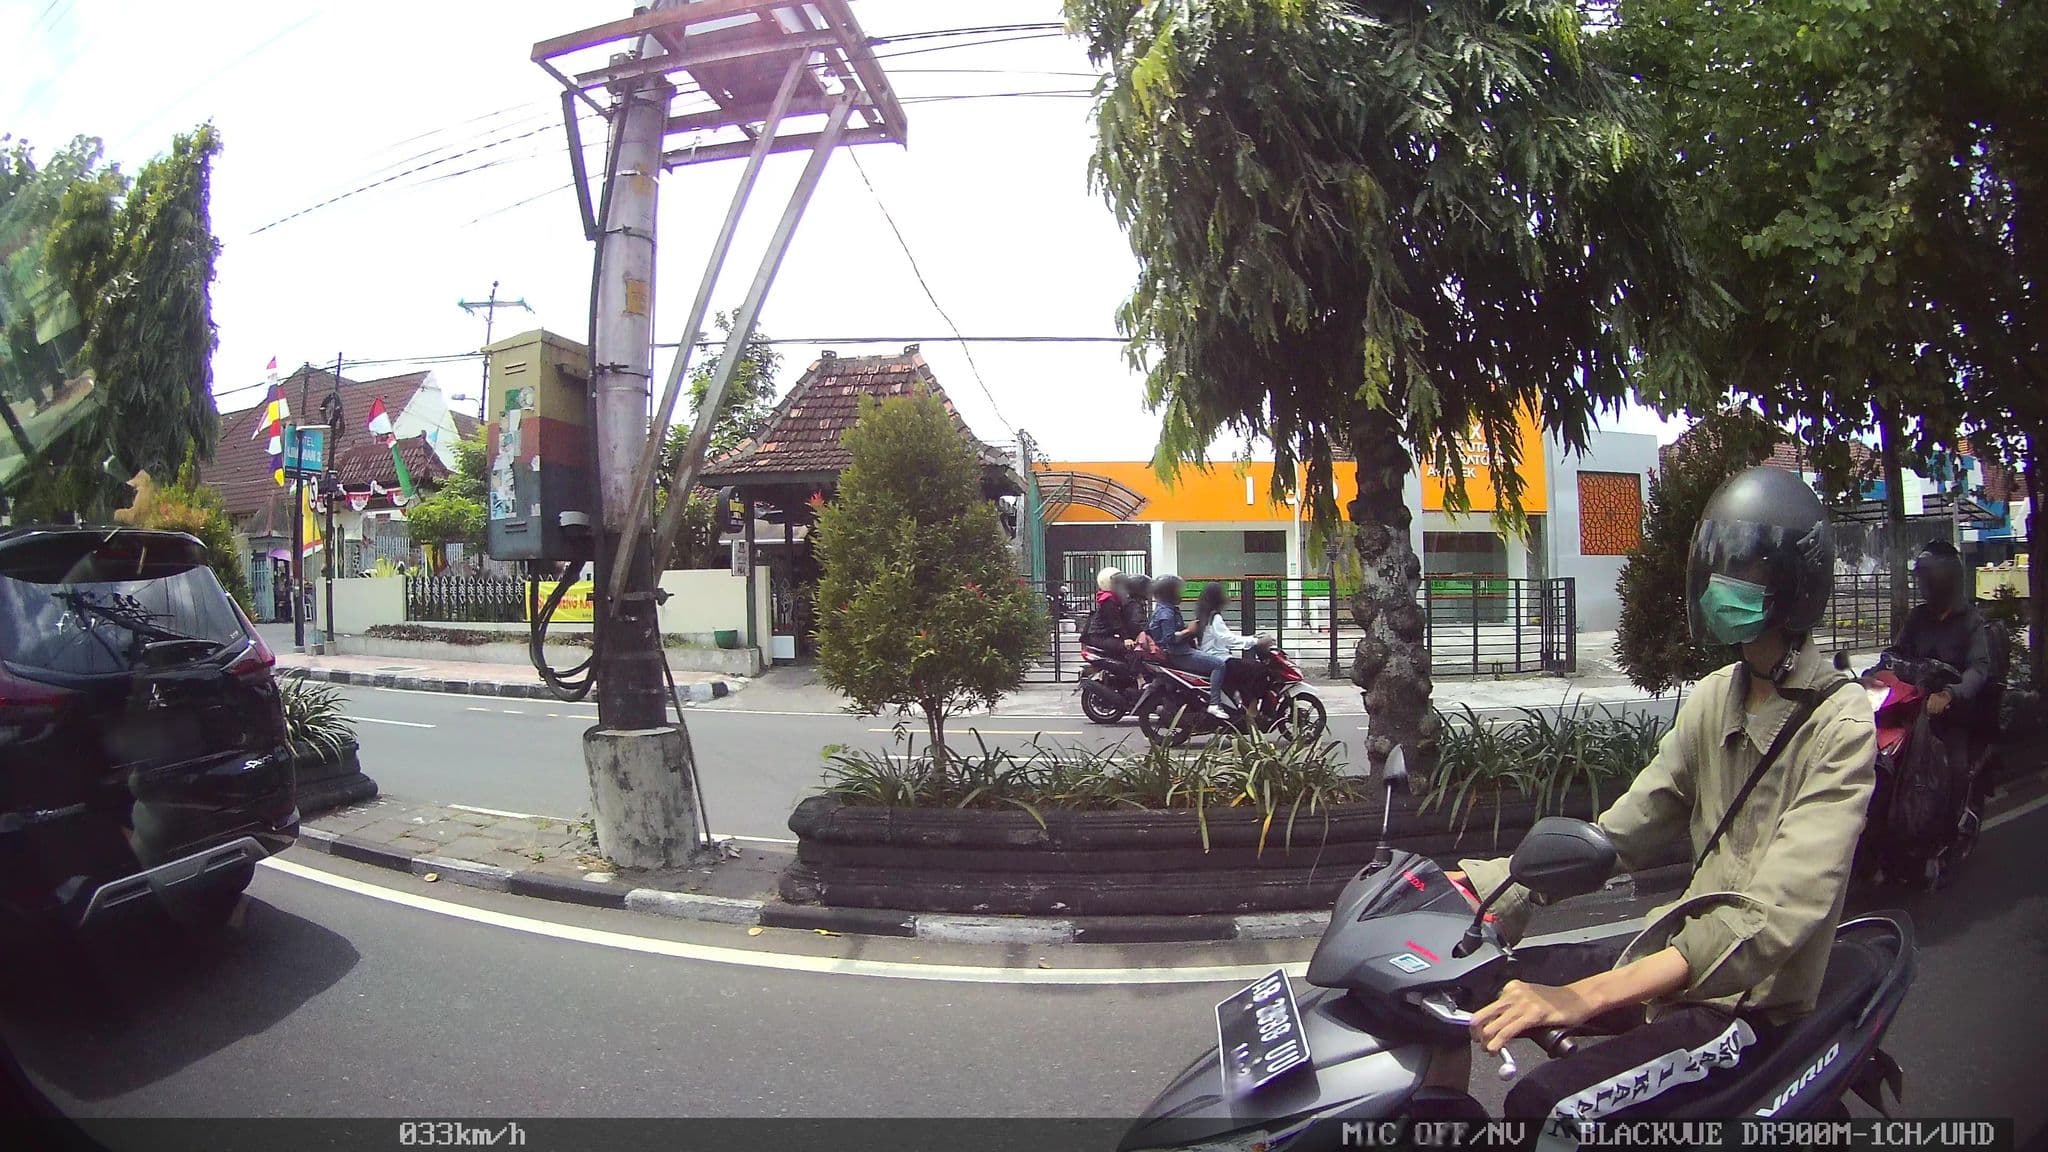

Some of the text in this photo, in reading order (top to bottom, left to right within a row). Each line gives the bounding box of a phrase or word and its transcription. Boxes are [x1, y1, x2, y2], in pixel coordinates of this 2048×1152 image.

[1251, 975, 1282, 1003] AB
[1264, 1039, 1300, 1073] UU
[1754, 1042, 1840, 1118] VARIO
